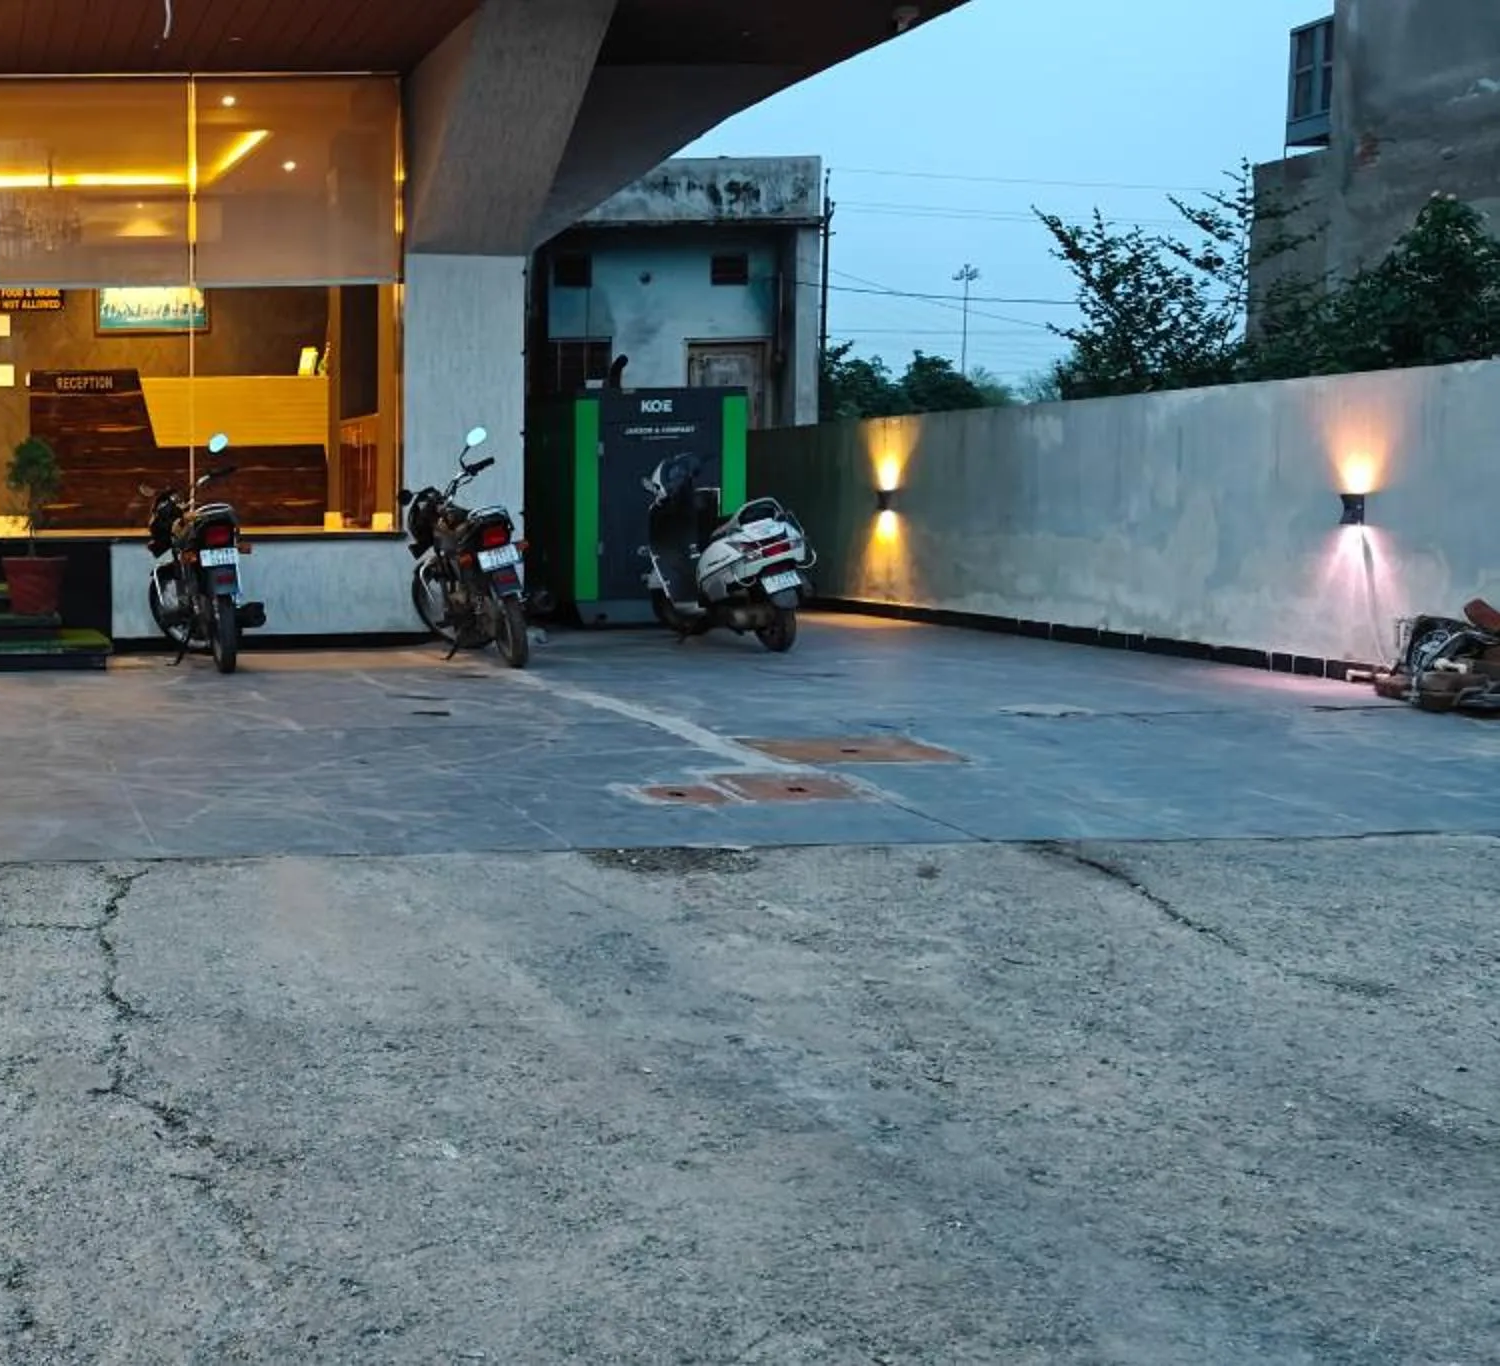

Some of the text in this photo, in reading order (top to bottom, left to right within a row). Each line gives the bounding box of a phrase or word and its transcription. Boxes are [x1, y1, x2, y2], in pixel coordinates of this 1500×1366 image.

[2, 300, 20, 310] NOT
[20, 299, 61, 310] ALLOWED
[56, 376, 113, 389] RECEPTION
[641, 399, 673, 413] KOE
